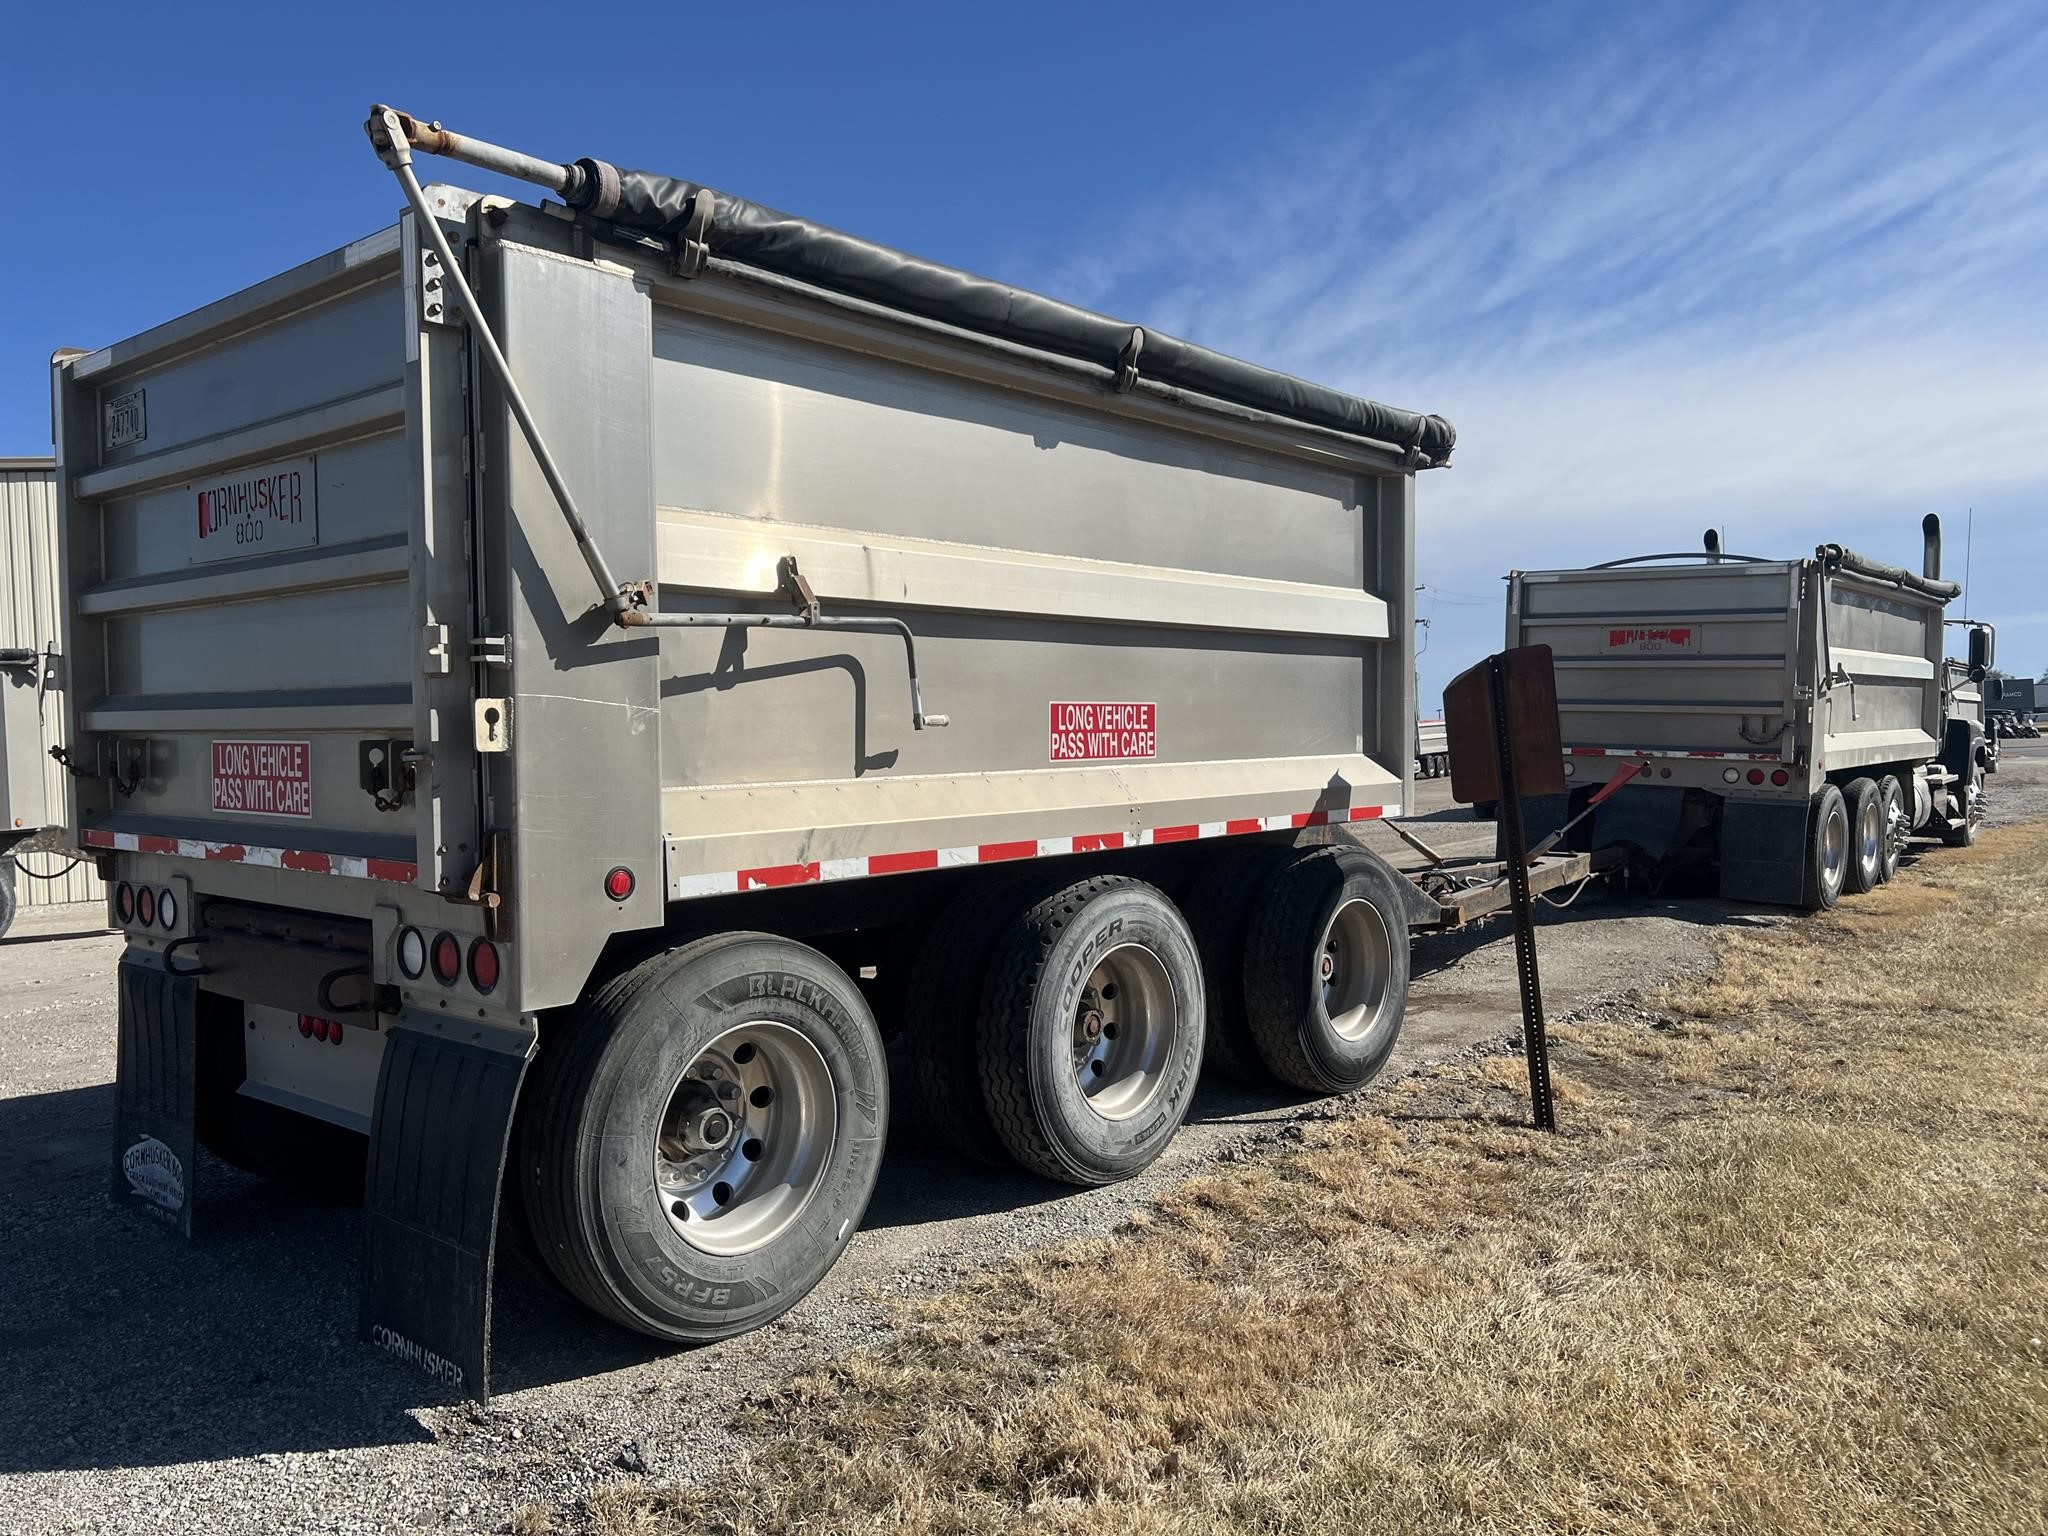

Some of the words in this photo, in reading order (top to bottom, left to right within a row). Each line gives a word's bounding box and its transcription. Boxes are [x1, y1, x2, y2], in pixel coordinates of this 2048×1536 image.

[236, 520, 264, 545] 800
[1058, 704, 1094, 731] LONG
[1096, 705, 1149, 730] VEHICLE
[1051, 732, 1085, 758] PASS
[1087, 732, 1118, 757] WITH
[1121, 731, 1154, 756] CARE
[219, 744, 250, 776] LONG
[252, 745, 303, 778] VEHICLE
[214, 777, 243, 809] PASS
[244, 778, 274, 811] WITH
[276, 780, 310, 813] CARE
[124, 1146, 171, 1173] CORNHUSKER
[644, 1255, 731, 1306] BFR57
[372, 1323, 464, 1387] CORNHUSKER
